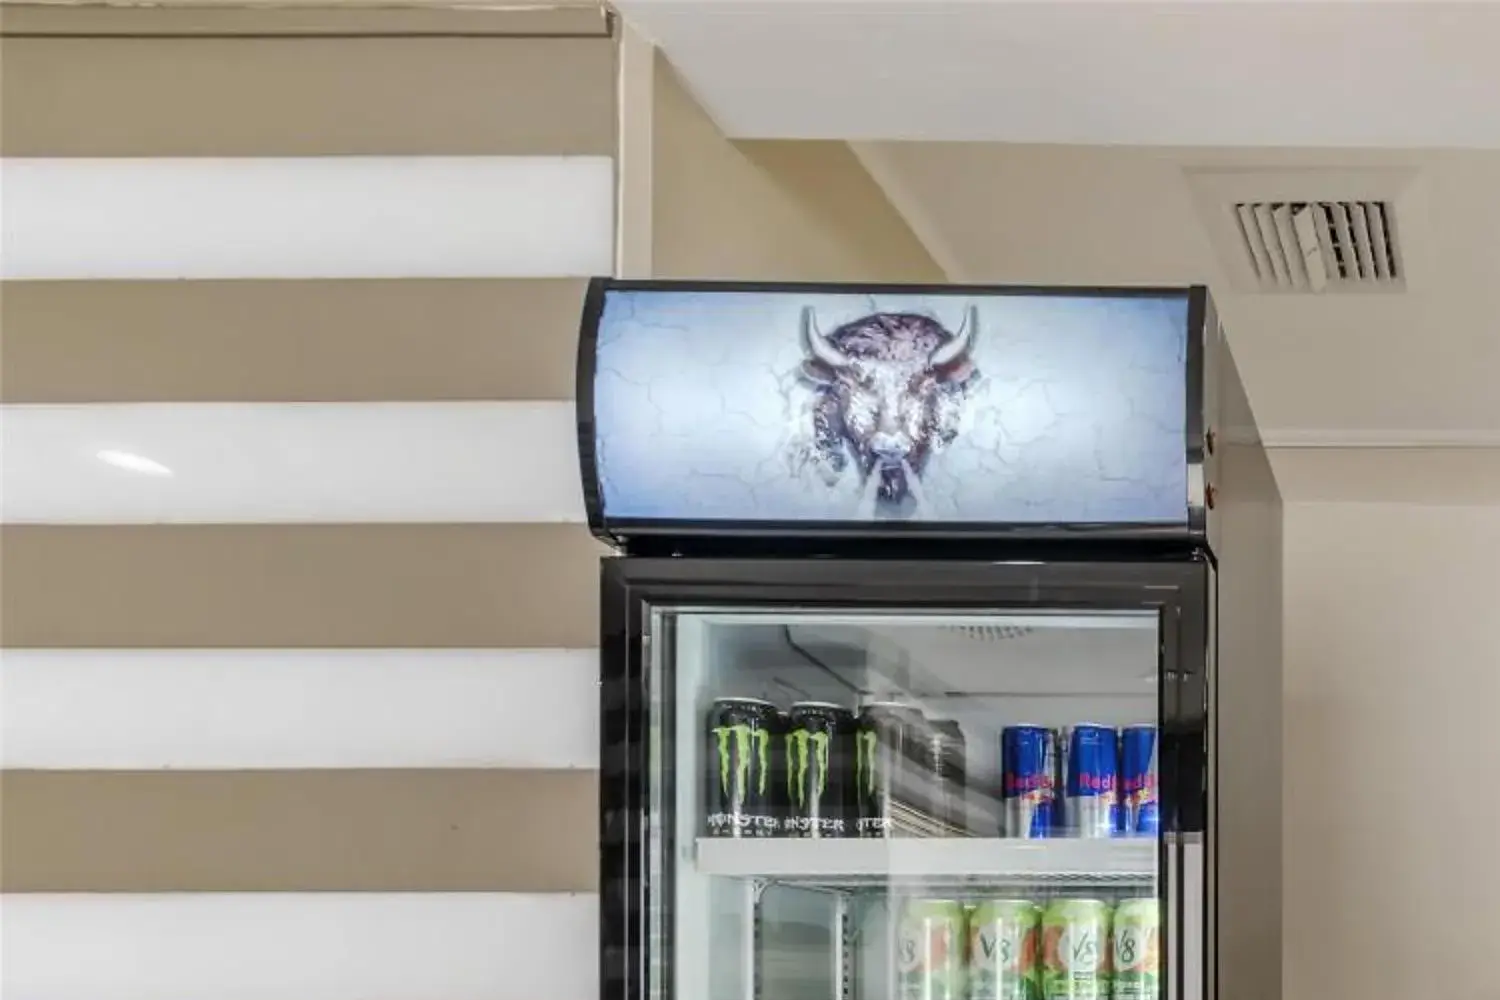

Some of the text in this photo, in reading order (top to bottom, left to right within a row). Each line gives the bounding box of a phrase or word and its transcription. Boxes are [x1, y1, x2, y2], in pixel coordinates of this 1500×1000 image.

[979, 932, 1011, 963] V8
[1072, 927, 1099, 963] V8
[1114, 929, 1138, 964] V8
